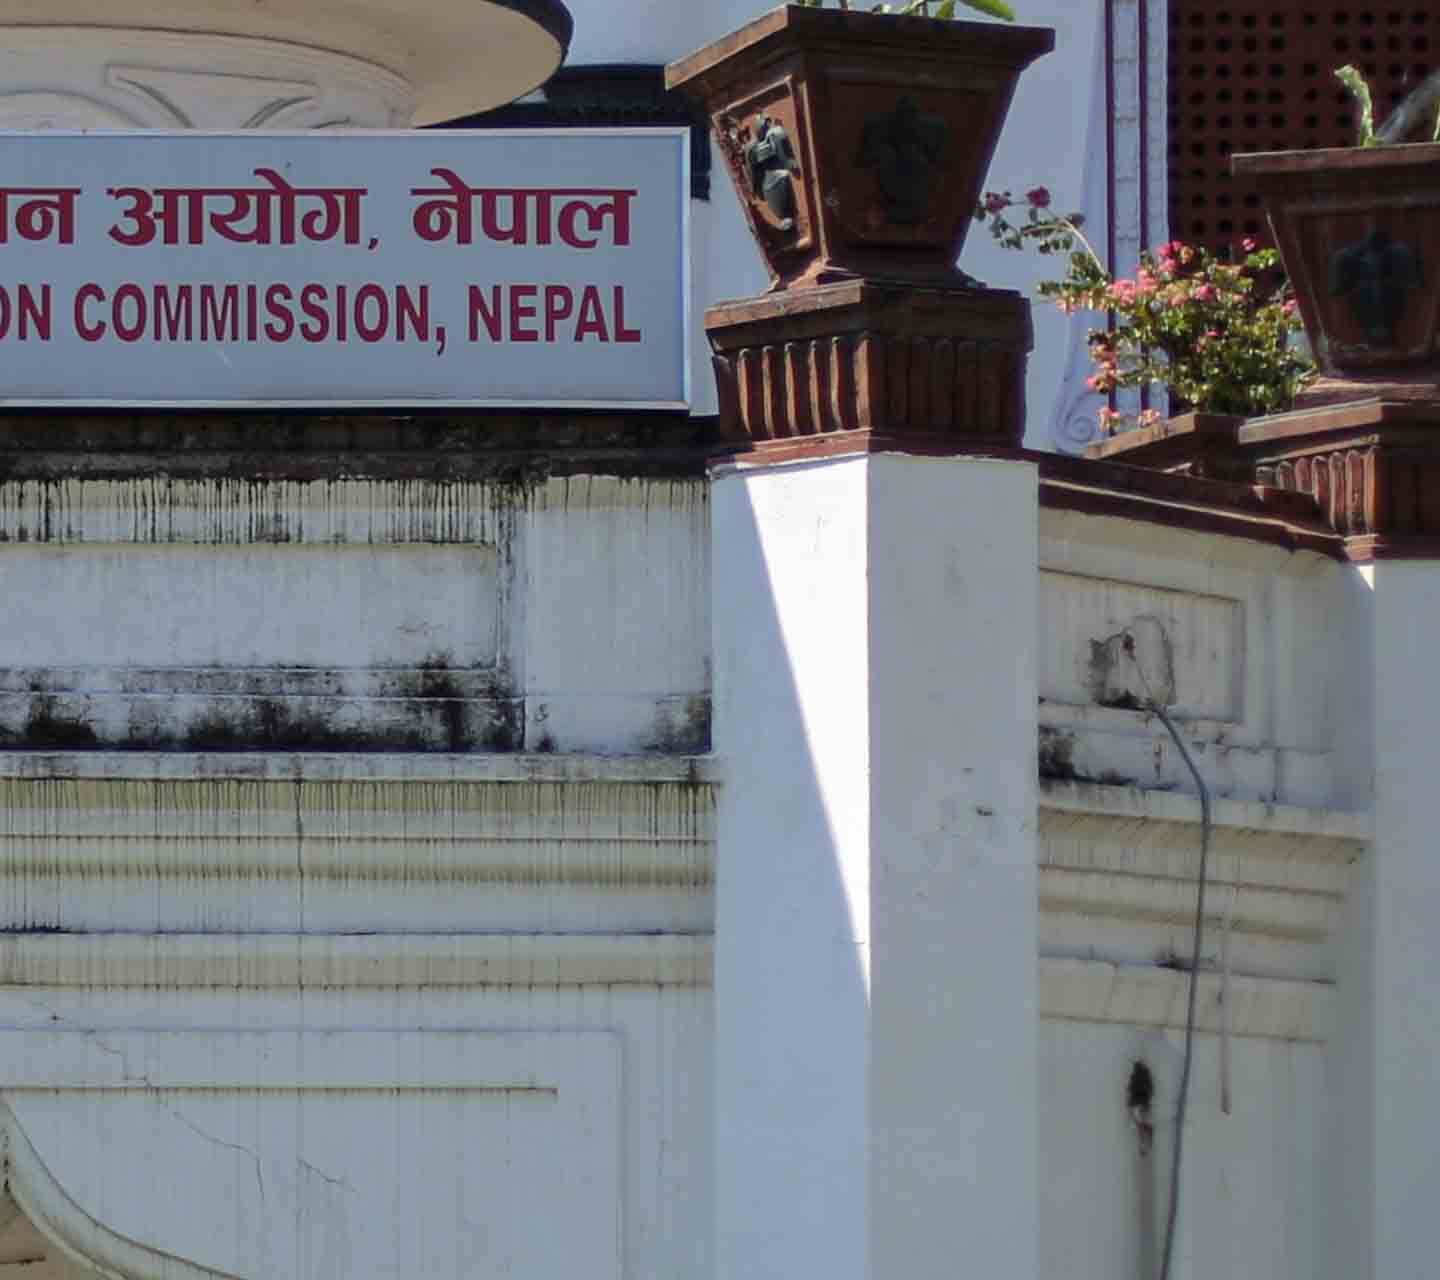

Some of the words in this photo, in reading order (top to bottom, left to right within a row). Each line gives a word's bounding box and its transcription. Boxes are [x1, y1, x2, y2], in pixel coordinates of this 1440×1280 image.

[106, 167, 380, 250] आयोग,
[410, 167, 638, 249] नेपाल
[74, 283, 446, 357] COMMISSION,
[468, 284, 642, 343] NEPAL
